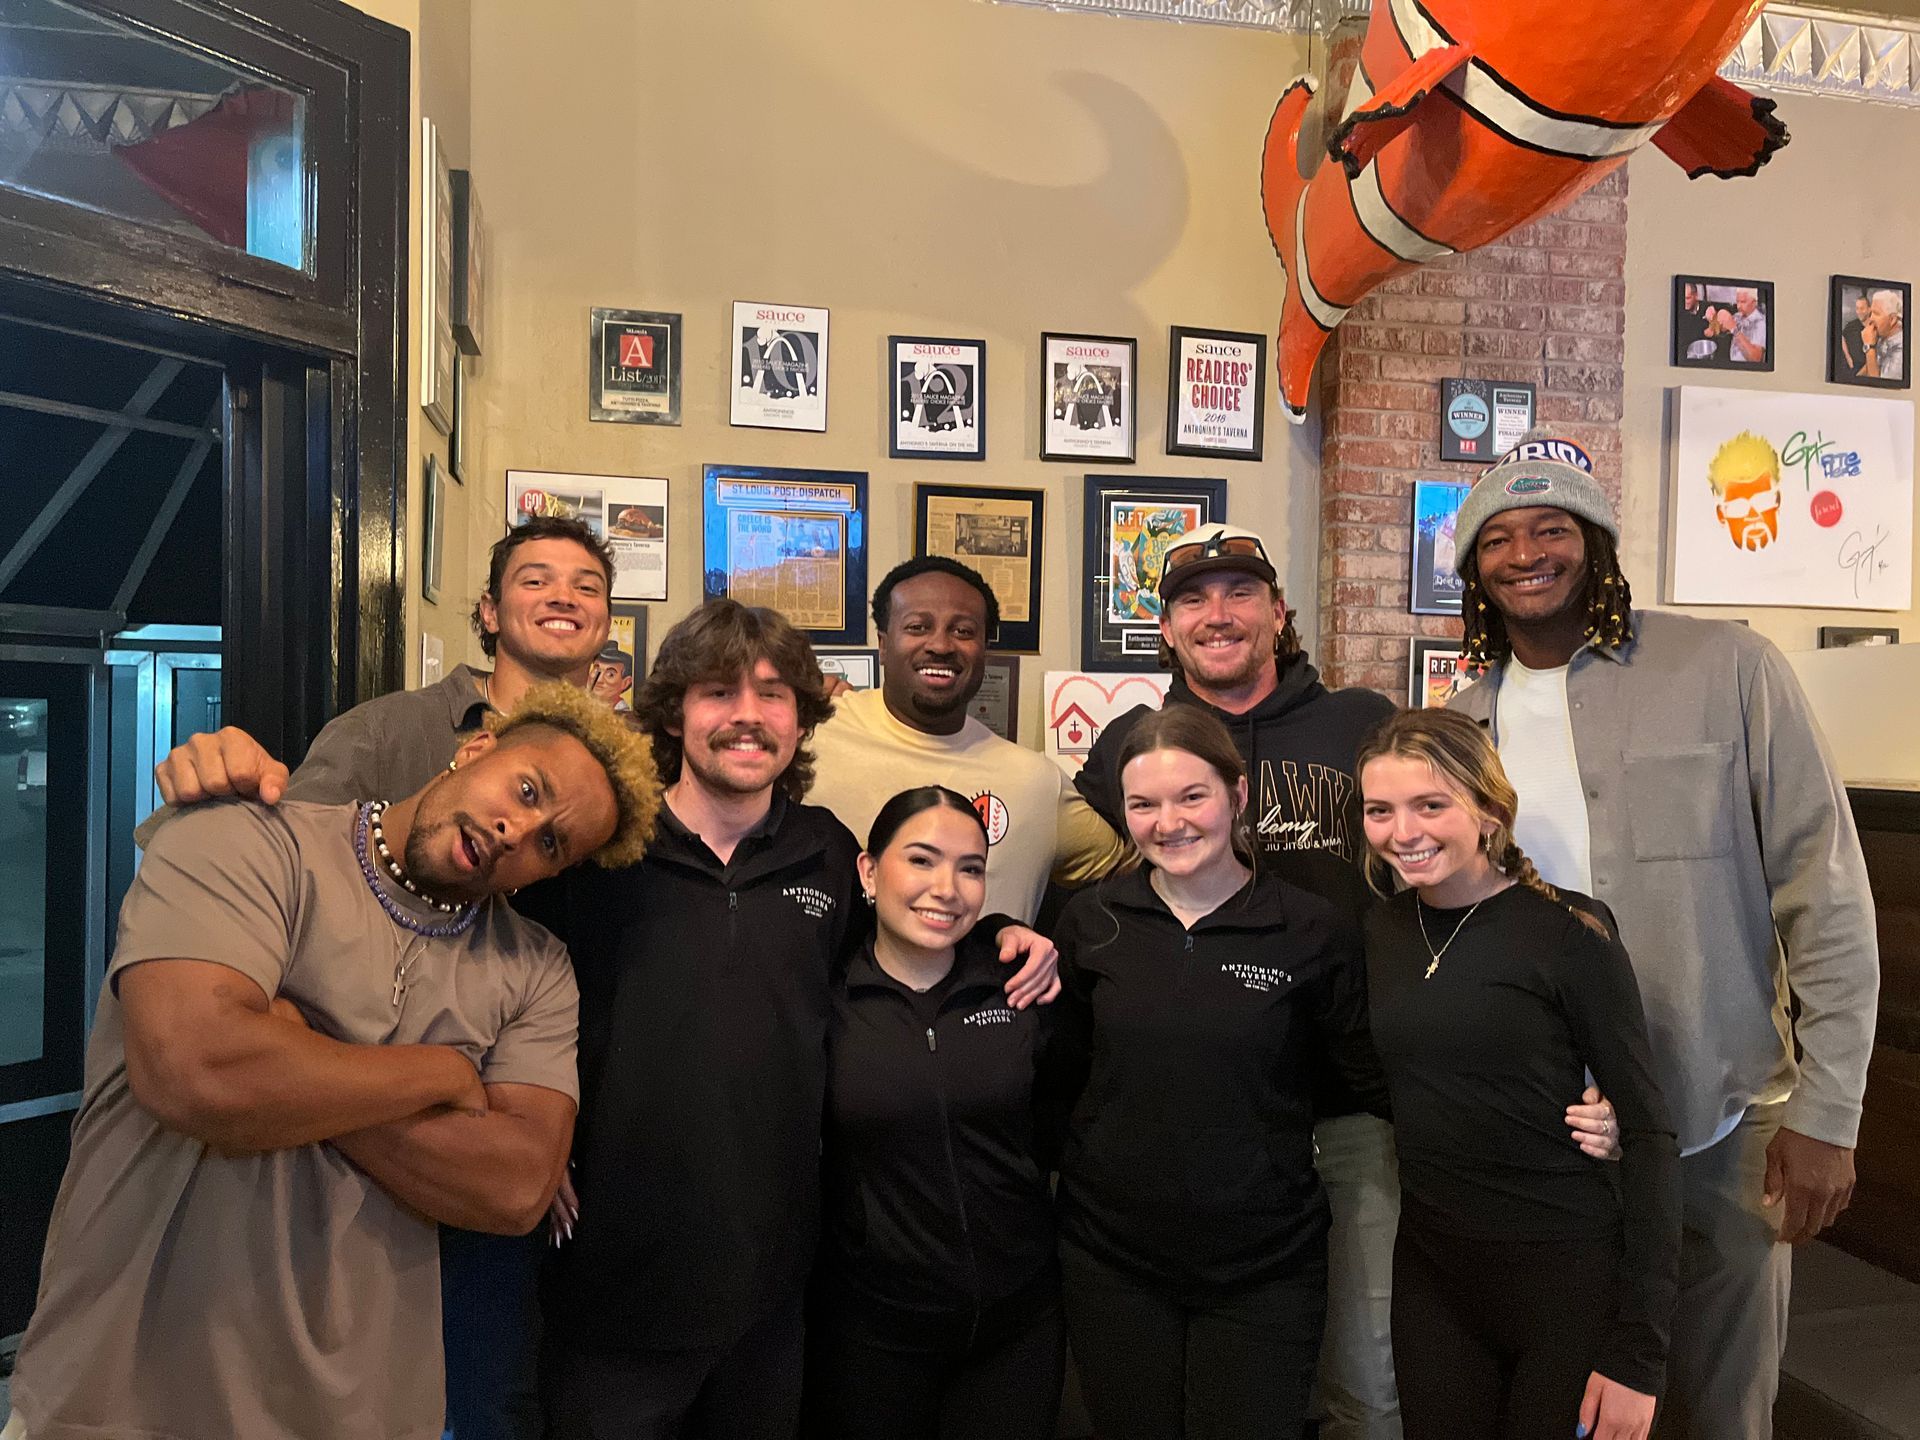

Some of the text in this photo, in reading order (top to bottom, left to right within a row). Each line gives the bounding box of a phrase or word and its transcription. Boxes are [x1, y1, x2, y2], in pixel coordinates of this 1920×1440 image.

[757, 310, 805, 322] sauce
[621, 335, 651, 367] A
[913, 345, 961, 355] sauce
[1066, 346, 1110, 357] sauce
[1195, 344, 1242, 356] sauce
[1187, 358, 1253, 386] READERS'
[1192, 384, 1241, 411] CHOICE
[1453, 412, 1483, 420] WINNER
[1223, 427, 1248, 438] TAVERNA
[745, 485, 771, 495] LOUIS
[524, 492, 543, 512] GO!
[1117, 510, 1144, 526] RFT
[1430, 659, 1456, 674] RFT
[1264, 837, 1342, 851] JIU JITSU & MMA
[795, 895, 828, 911] TAVERNA
[1221, 963, 1292, 982] ANTHONINO'S
[1234, 971, 1279, 986] TAVERNA
[976, 1016, 1011, 1026] TAVERNA
